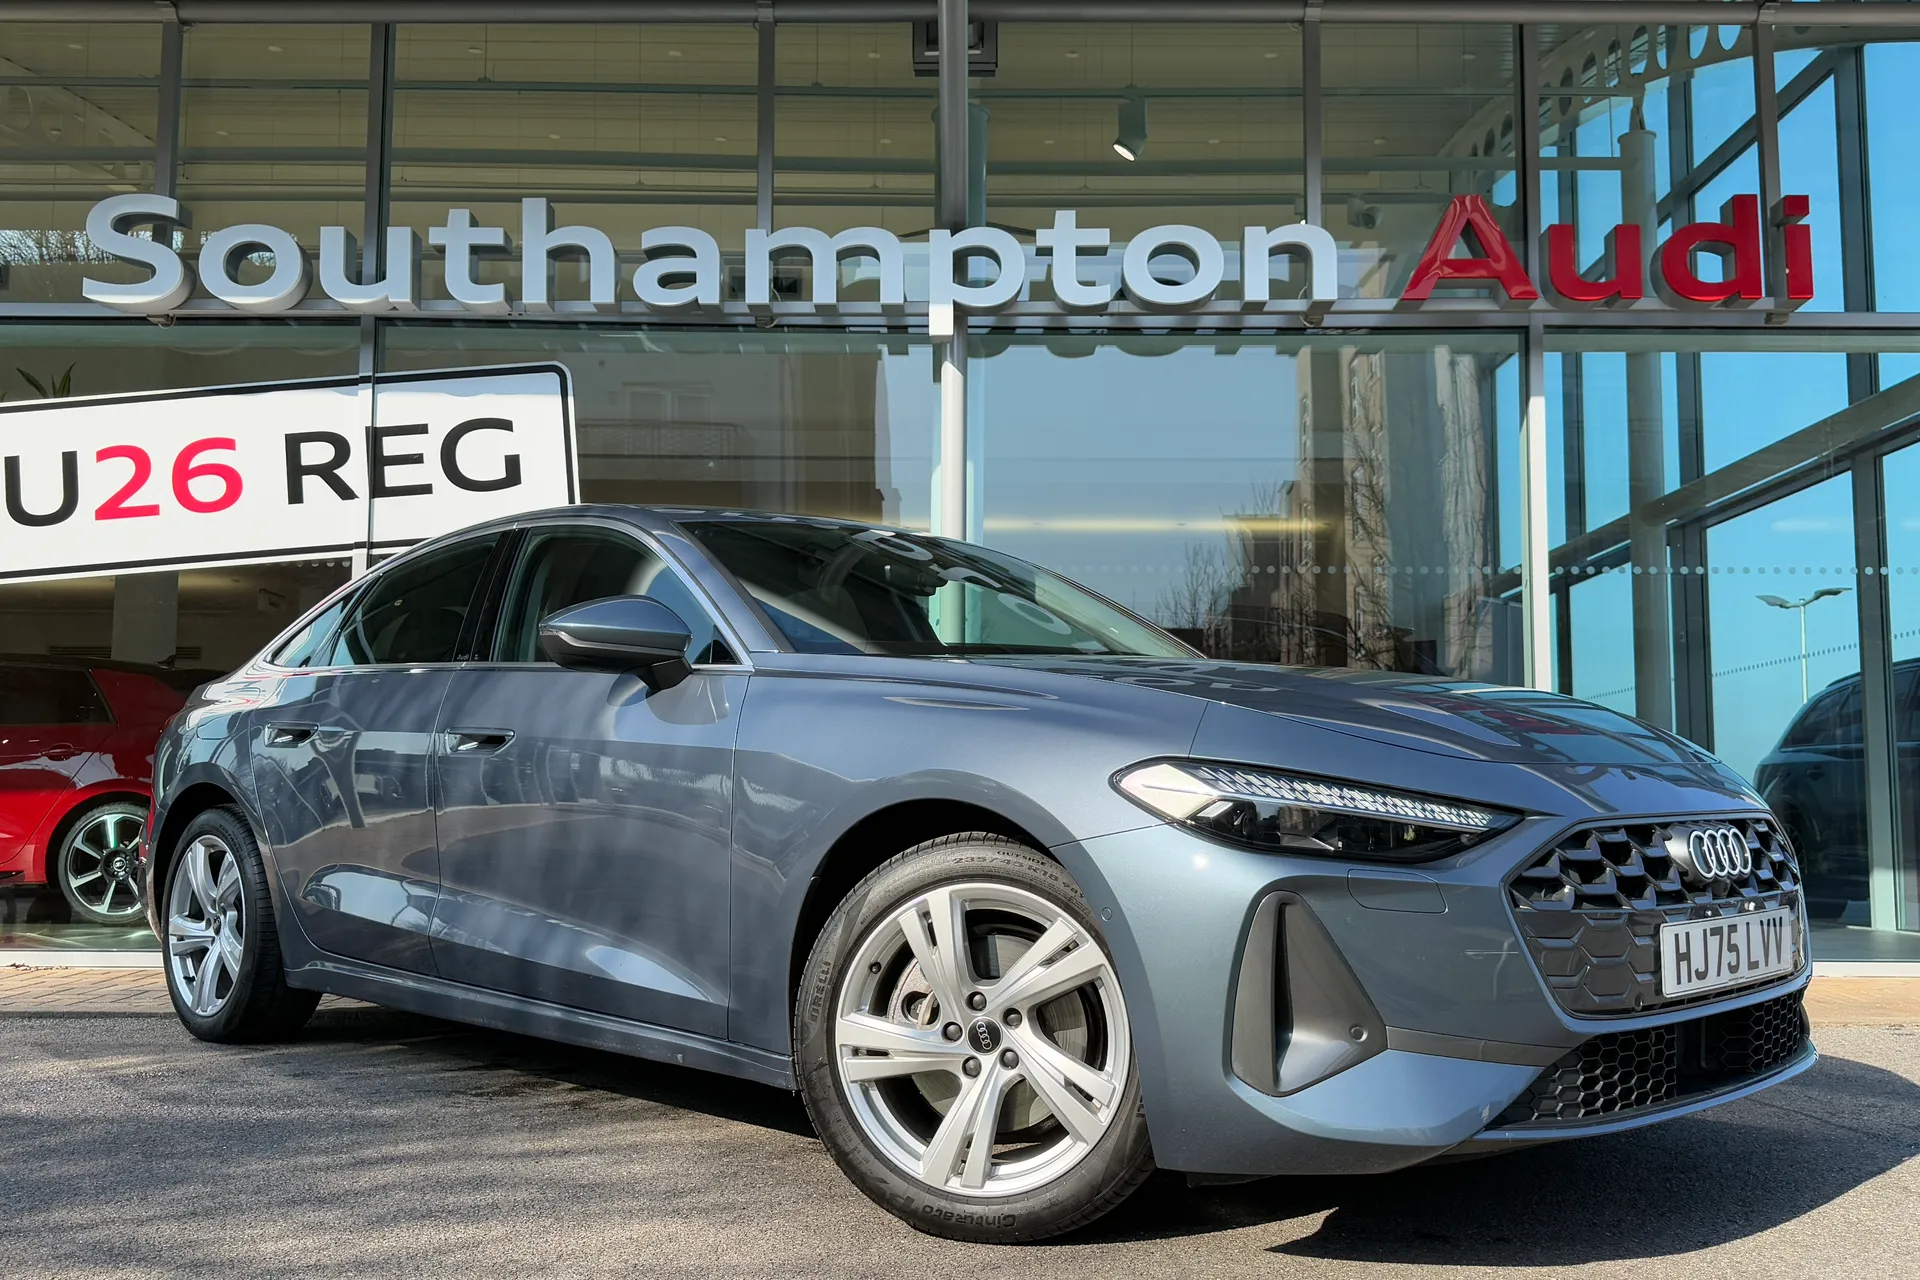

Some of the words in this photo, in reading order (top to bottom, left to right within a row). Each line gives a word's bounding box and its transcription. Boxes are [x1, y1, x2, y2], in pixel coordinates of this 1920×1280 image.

[82, 193, 1339, 338] Southampton
[1400, 193, 1813, 302] Audi
[3, 436, 244, 528] U26
[284, 417, 523, 505] REG
[1674, 923, 1740, 986] HJ75
[1745, 916, 1783, 971] LVV
